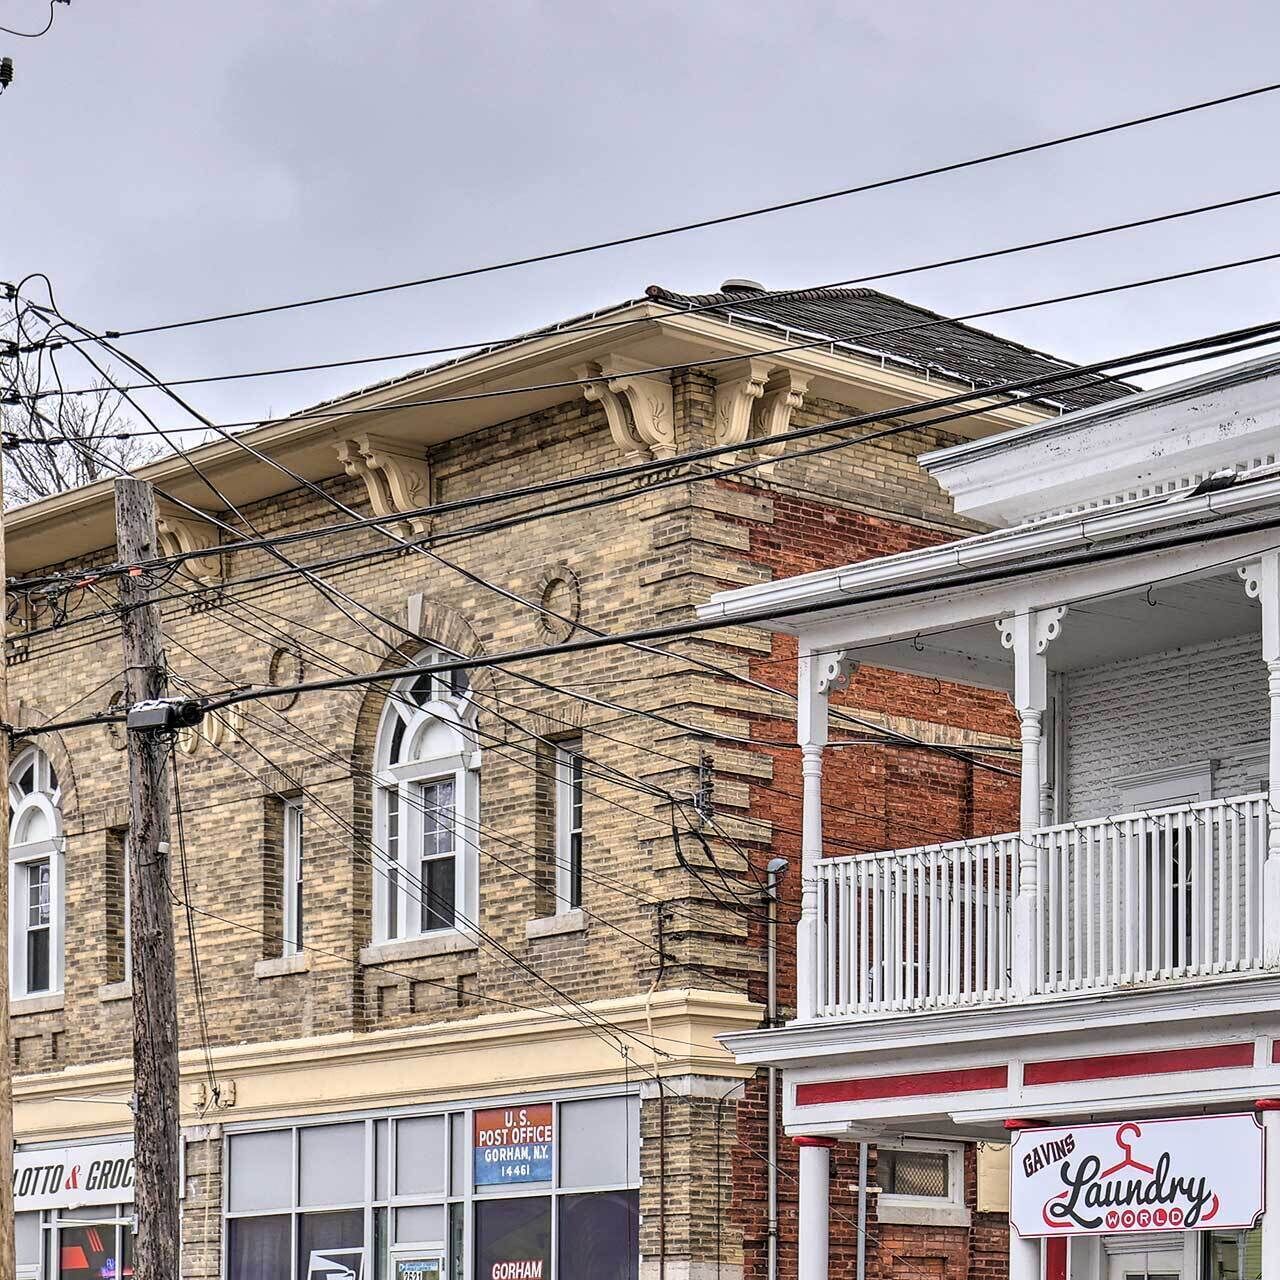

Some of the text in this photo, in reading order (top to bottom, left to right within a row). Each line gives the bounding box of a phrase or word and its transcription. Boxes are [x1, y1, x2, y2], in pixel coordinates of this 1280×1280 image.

[479, 1125, 552, 1147] POST OFFICE
[484, 1144, 549, 1163] GORHAM, N.Y.
[1022, 1133, 1077, 1178] GAVINS
[65, 1165, 81, 1190] &
[501, 1164, 530, 1177] 14461
[1050, 1151, 1212, 1229] Laundry
[1105, 1207, 1184, 1229] WORLD
[492, 1260, 543, 1280] GORHAM
